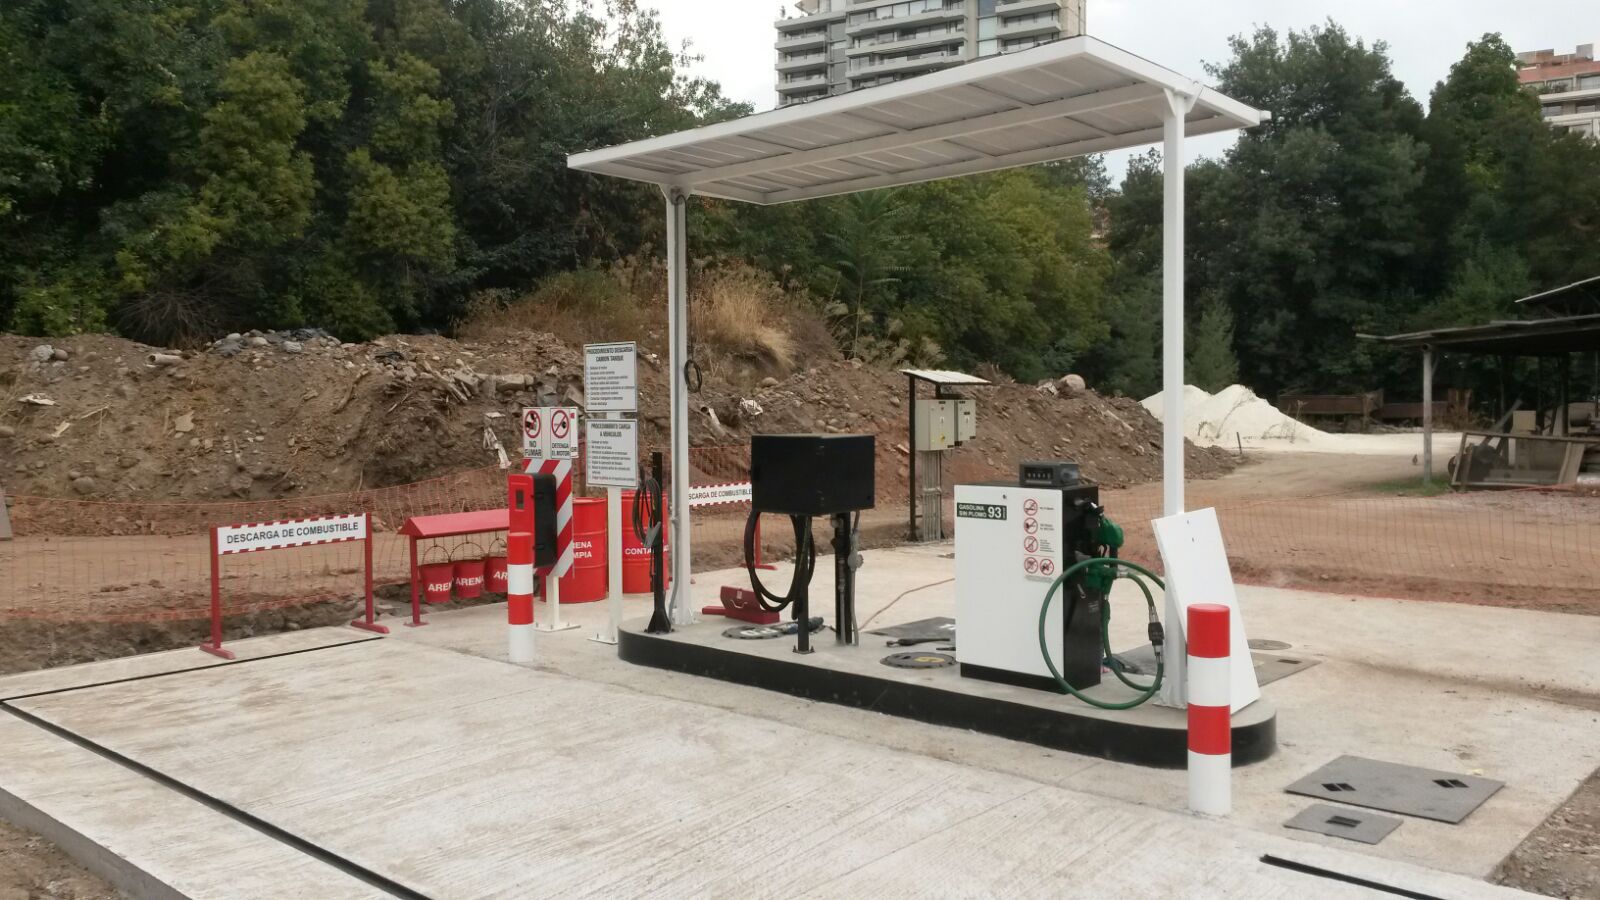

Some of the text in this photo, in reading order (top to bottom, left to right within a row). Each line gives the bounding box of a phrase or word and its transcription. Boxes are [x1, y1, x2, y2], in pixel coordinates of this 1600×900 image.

[524, 448, 542, 456] FUMAR
[718, 488, 752, 497] COMBUSTIBLE
[988, 506, 1002, 518] 93
[226, 522, 358, 544] DESCARGA DE COMBUSTIBLE
